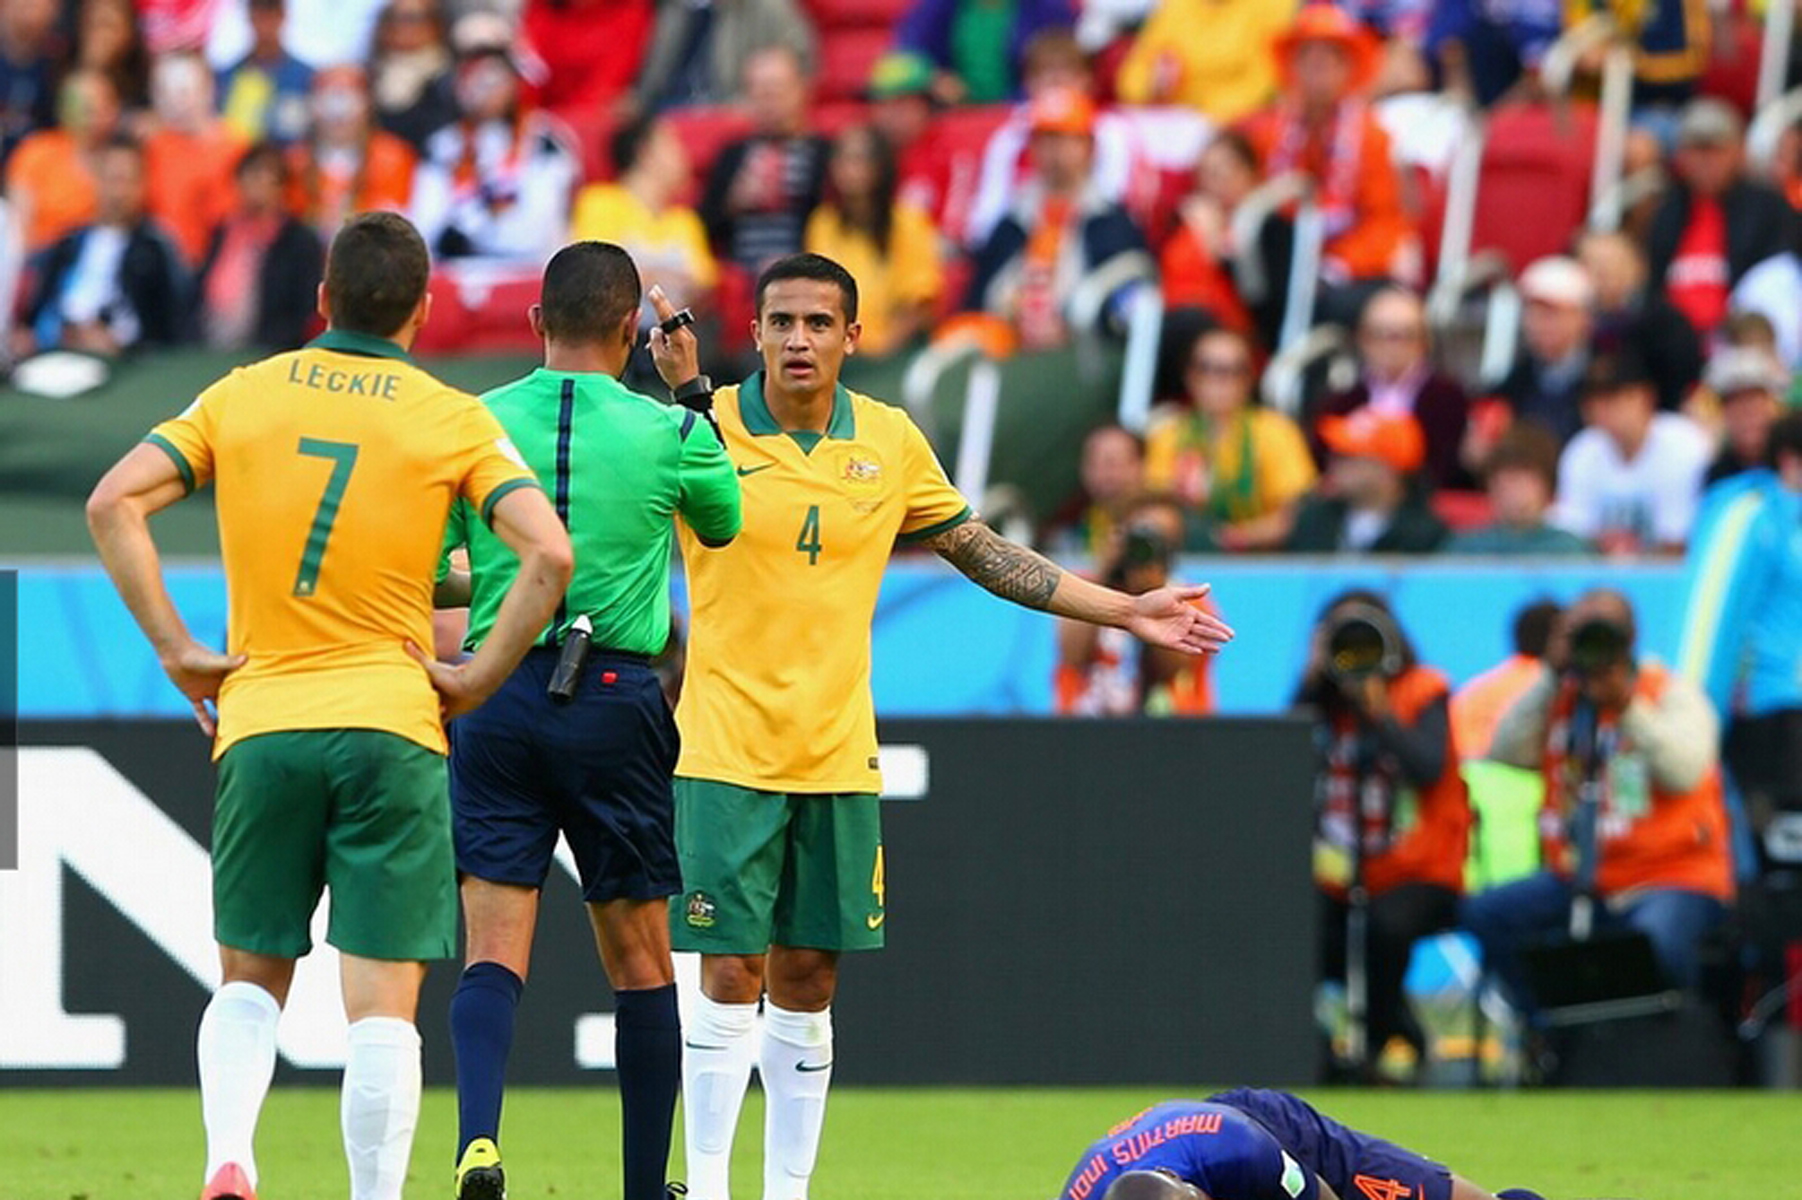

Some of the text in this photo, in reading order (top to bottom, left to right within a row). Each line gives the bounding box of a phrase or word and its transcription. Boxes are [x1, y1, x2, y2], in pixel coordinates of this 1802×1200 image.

[288, 358, 402, 401] LECKIE
[293, 437, 359, 597] 7
[796, 505, 822, 566] 4
[872, 845, 885, 907] 4
[1112, 1114, 1222, 1165] MARTINS
